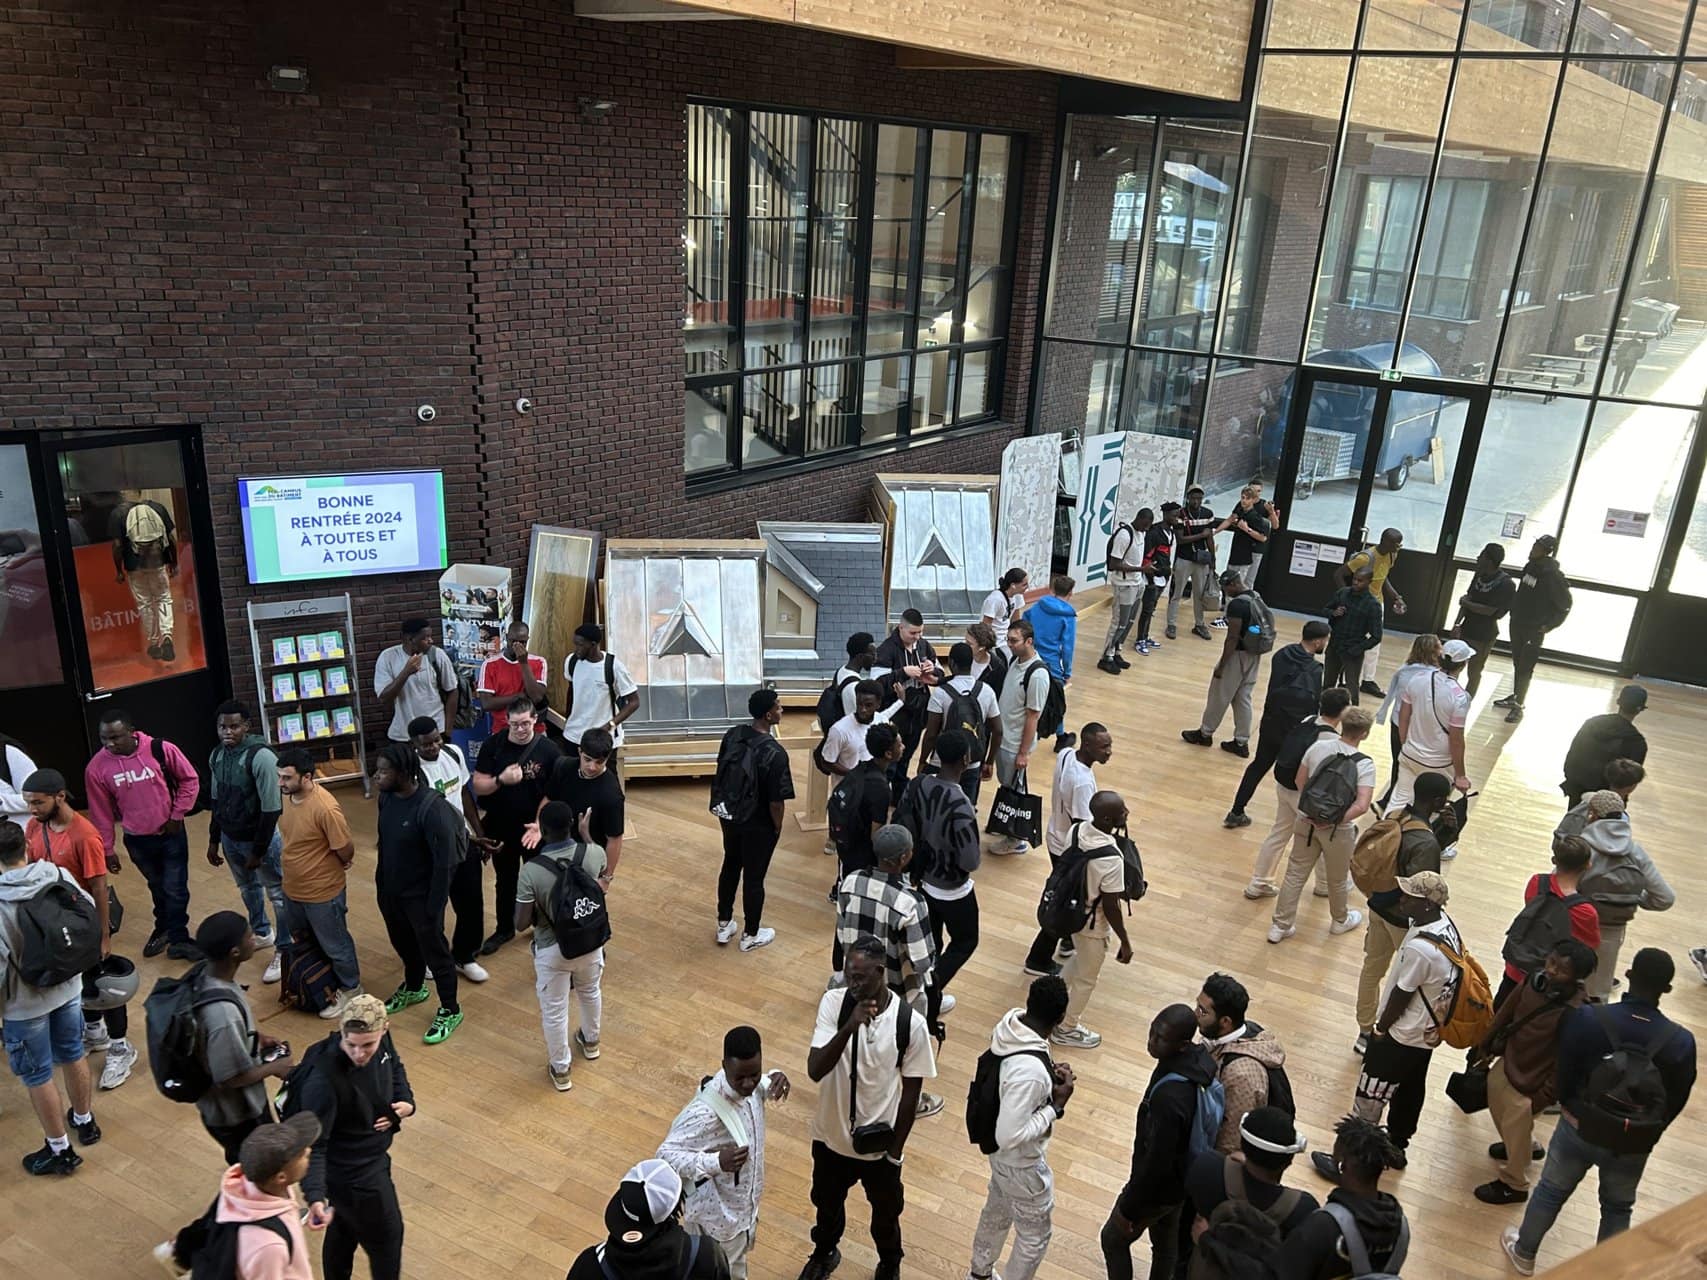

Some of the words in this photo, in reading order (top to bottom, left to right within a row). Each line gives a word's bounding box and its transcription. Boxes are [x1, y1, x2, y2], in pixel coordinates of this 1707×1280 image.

[318, 495, 374, 509] BONNE
[291, 512, 361, 529] RENTRÉE
[365, 511, 402, 525] 2024
[301, 532, 312, 547] À
[314, 531, 375, 545] TOUTES
[379, 529, 396, 541] ET
[323, 549, 334, 564] À
[336, 548, 378, 562] TOUS
[91, 609, 143, 631] BÂTIM
[185, 600, 194, 612] B
[284, 601, 318, 616] info
[463, 619, 500, 627] VIVRE
[443, 638, 496, 650] ENCORE
[113, 766, 155, 787] FILA
